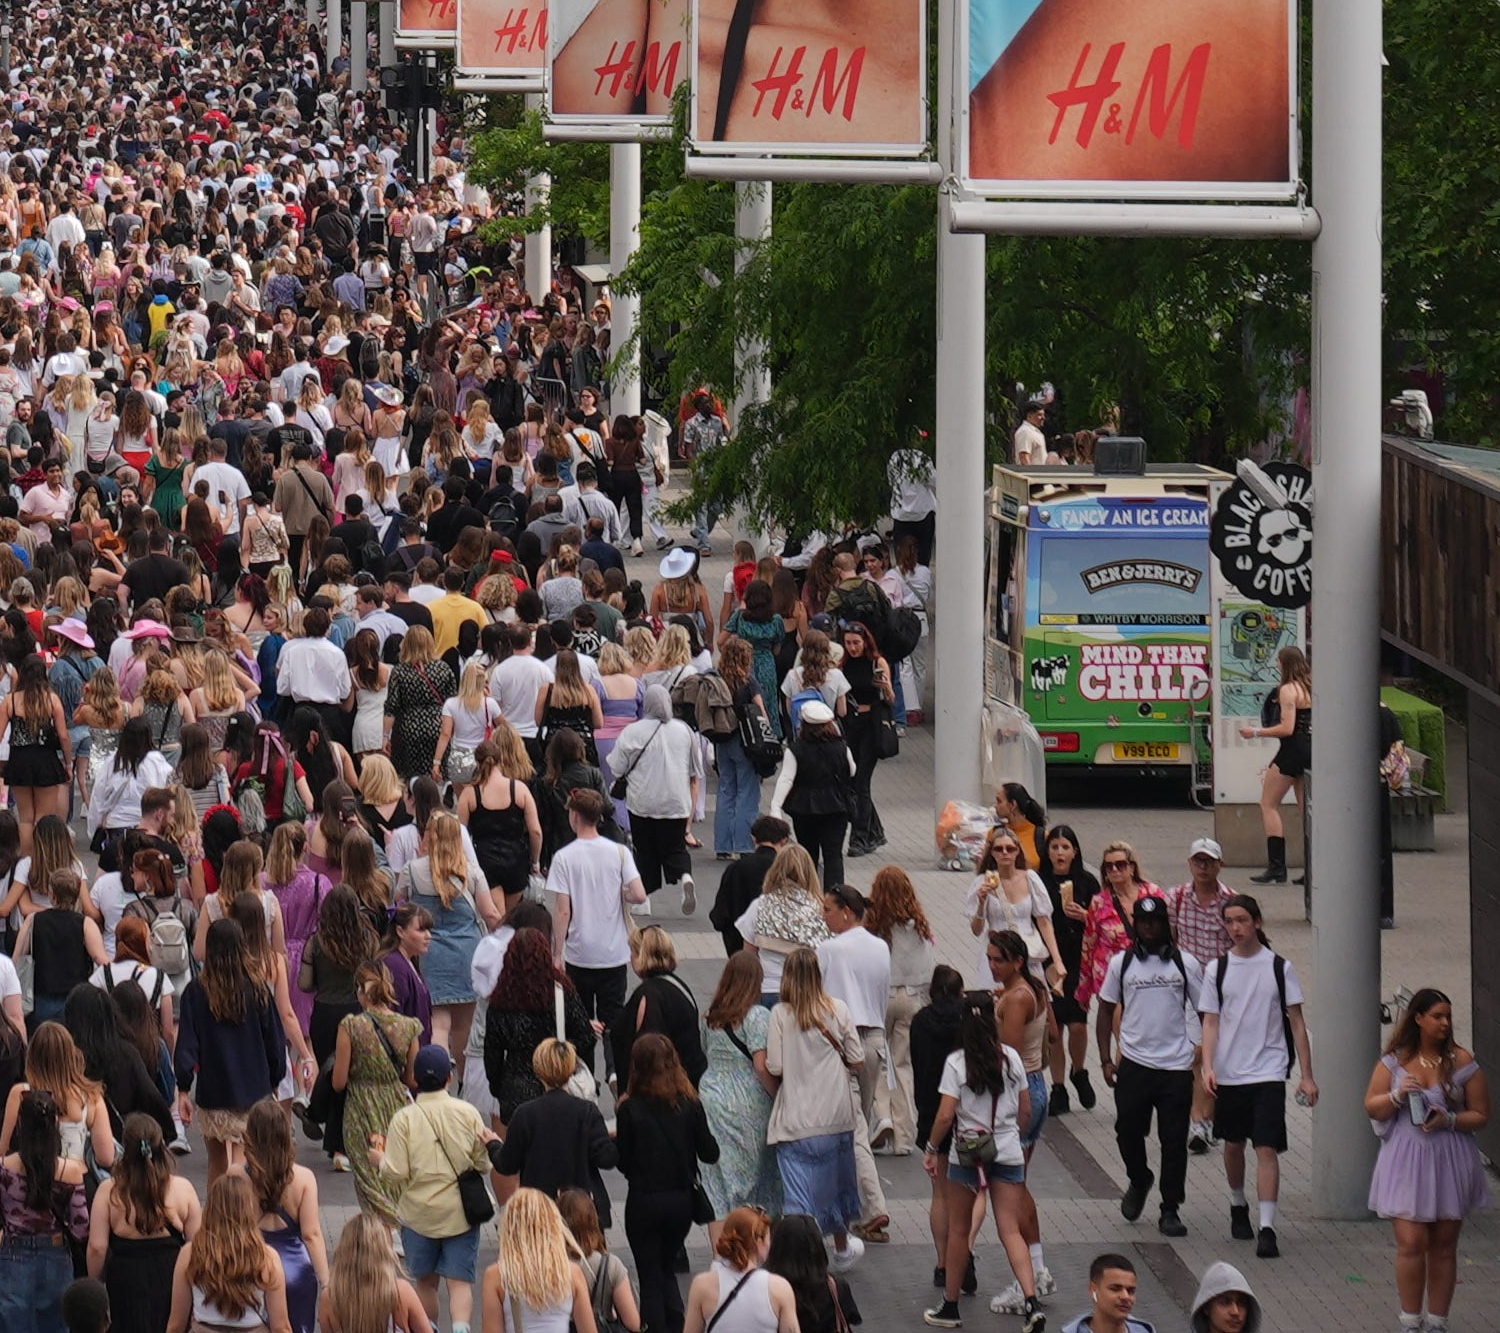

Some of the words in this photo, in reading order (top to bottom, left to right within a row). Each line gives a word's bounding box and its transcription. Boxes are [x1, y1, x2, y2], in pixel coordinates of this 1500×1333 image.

[593, 39, 683, 100] H&M
[752, 45, 866, 123] H&M
[1047, 41, 1212, 150] H&M
[1062, 508, 1109, 526] FANCY
[1112, 508, 1132, 525] AN
[1137, 508, 1158, 526] ICE
[1162, 508, 1209, 526] CREAM
[1224, 489, 1266, 548] BLAC
[1094, 614, 1137, 624] WHITBY
[1139, 614, 1201, 624] MORRISON
[1082, 645, 1143, 664] MIND
[1147, 645, 1207, 664] THAT
[1080, 664, 1210, 701] CHILD
[1123, 746, 1147, 757] V99
[1149, 746, 1170, 757] ECO
